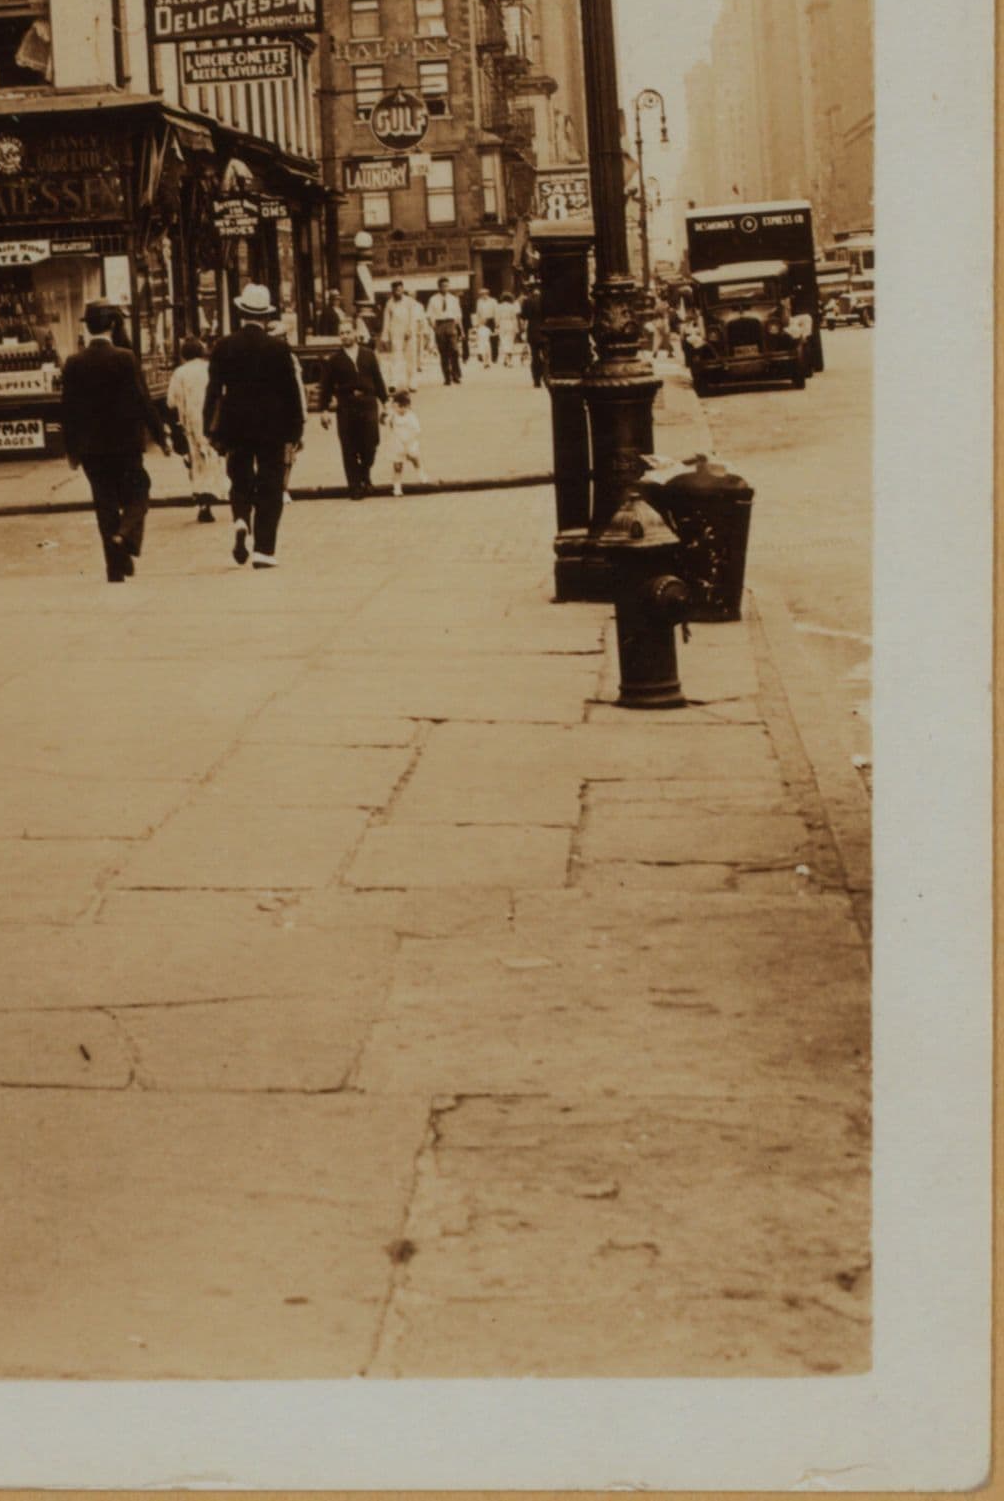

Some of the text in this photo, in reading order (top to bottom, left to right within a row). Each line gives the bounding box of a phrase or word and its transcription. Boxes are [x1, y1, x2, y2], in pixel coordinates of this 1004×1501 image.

[245, 13, 316, 29] SANDWICHES
[186, 48, 288, 73] LUNCHEONETTE
[375, 106, 426, 137] GULF
[345, 161, 407, 190] LAUNDRY
[541, 180, 586, 196] SALE
[0, 254, 32, 264] TEA
